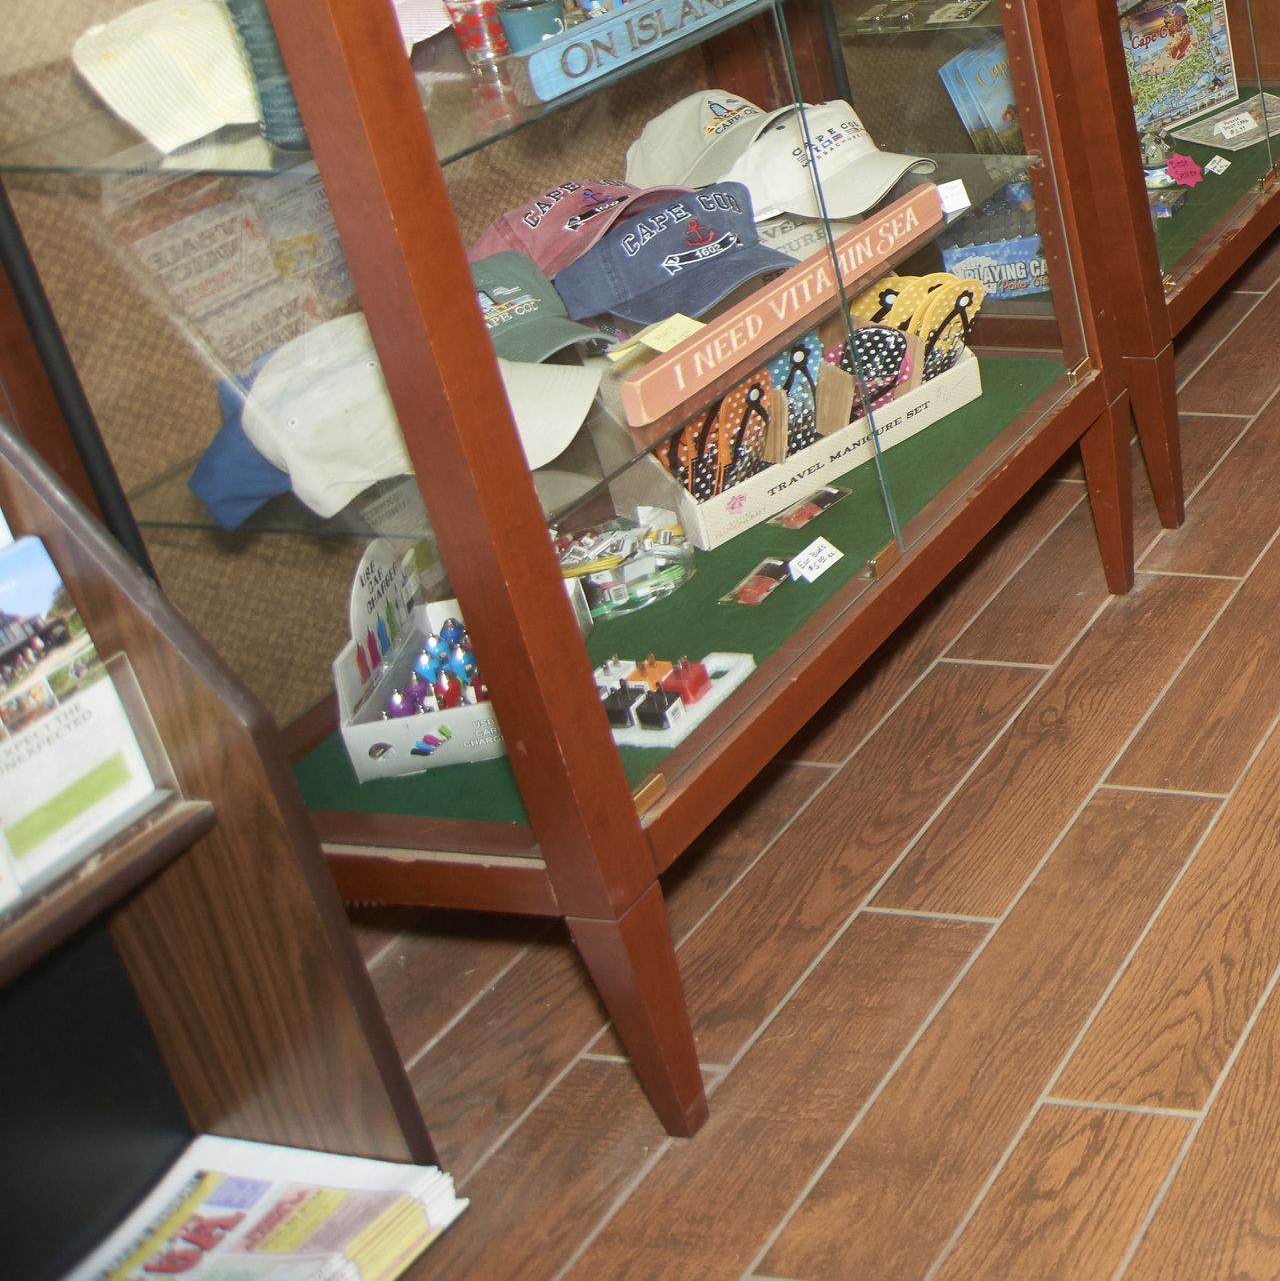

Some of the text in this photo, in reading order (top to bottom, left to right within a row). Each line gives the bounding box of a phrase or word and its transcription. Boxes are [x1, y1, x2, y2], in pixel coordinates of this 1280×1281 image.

[560, 30, 617, 79] ON
[1131, 33, 1158, 52] Cape
[522, 181, 586, 230] CAPE
[620, 191, 743, 257] CAPE COD
[695, 242, 724, 258] 1602
[963, 262, 1027, 285] PLAYING
[514, 301, 540, 316] COD
[673, 364, 687, 391] I
[693, 315, 763, 377] NEED
[768, 238, 875, 321] VITAMIN
[876, 206, 920, 256] SEA
[766, 400, 932, 498] TRAVEL MANICURE SET
[796, 542, 827, 570] Ear Buds
[359, 559, 377, 589] USB
[366, 560, 400, 616] CHARGER
[367, 566, 385, 595] CAR
[3, 700, 83, 756] XPECT THE
[471, 718, 496, 729] USB
[475, 727, 498, 738] CAR
[4, 708, 94, 772] NEXPECTED
